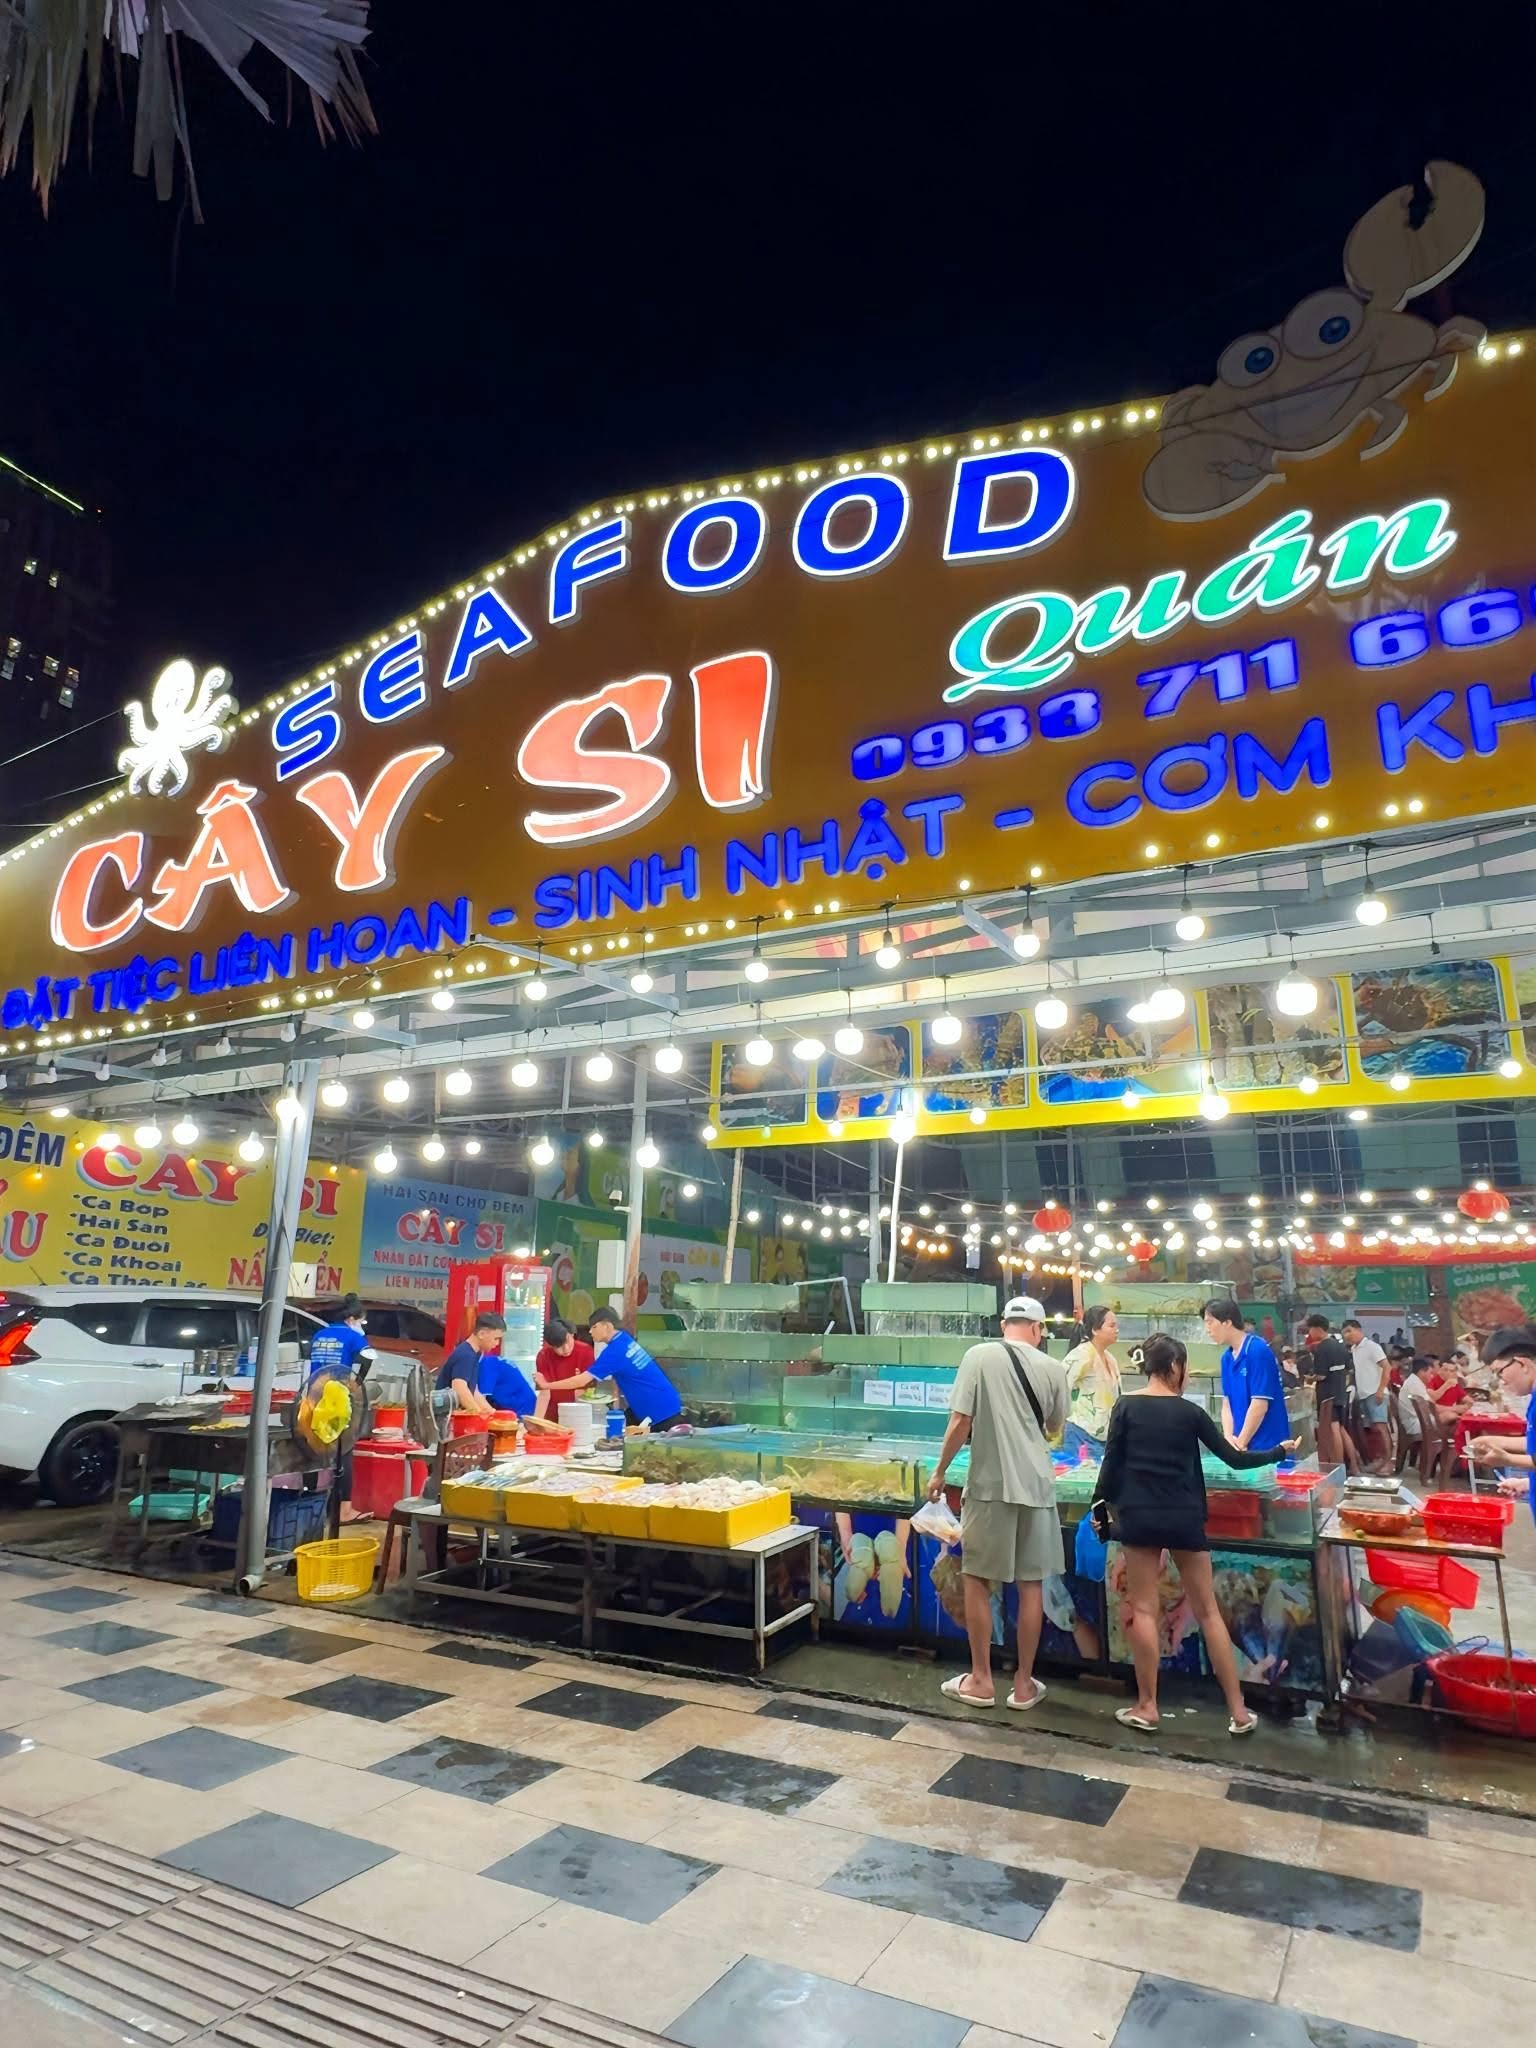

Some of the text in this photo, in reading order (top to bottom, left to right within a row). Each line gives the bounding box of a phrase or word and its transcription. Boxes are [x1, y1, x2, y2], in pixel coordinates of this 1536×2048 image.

[272, 446, 1077, 782] SEAFOOD
[942, 499, 1458, 703] Quán
[1136, 638, 1299, 719] 711
[1351, 584, 1536, 666] 66
[50, 650, 773, 952] CÂY SI
[188, 931, 293, 995] LIÊN
[307, 896, 469, 974] HOAN
[534, 846, 697, 928] SINH
[726, 797, 964, 895] NHẬT
[1066, 717, 1332, 828] CƠM
[475, 1223, 506, 1250] SI
